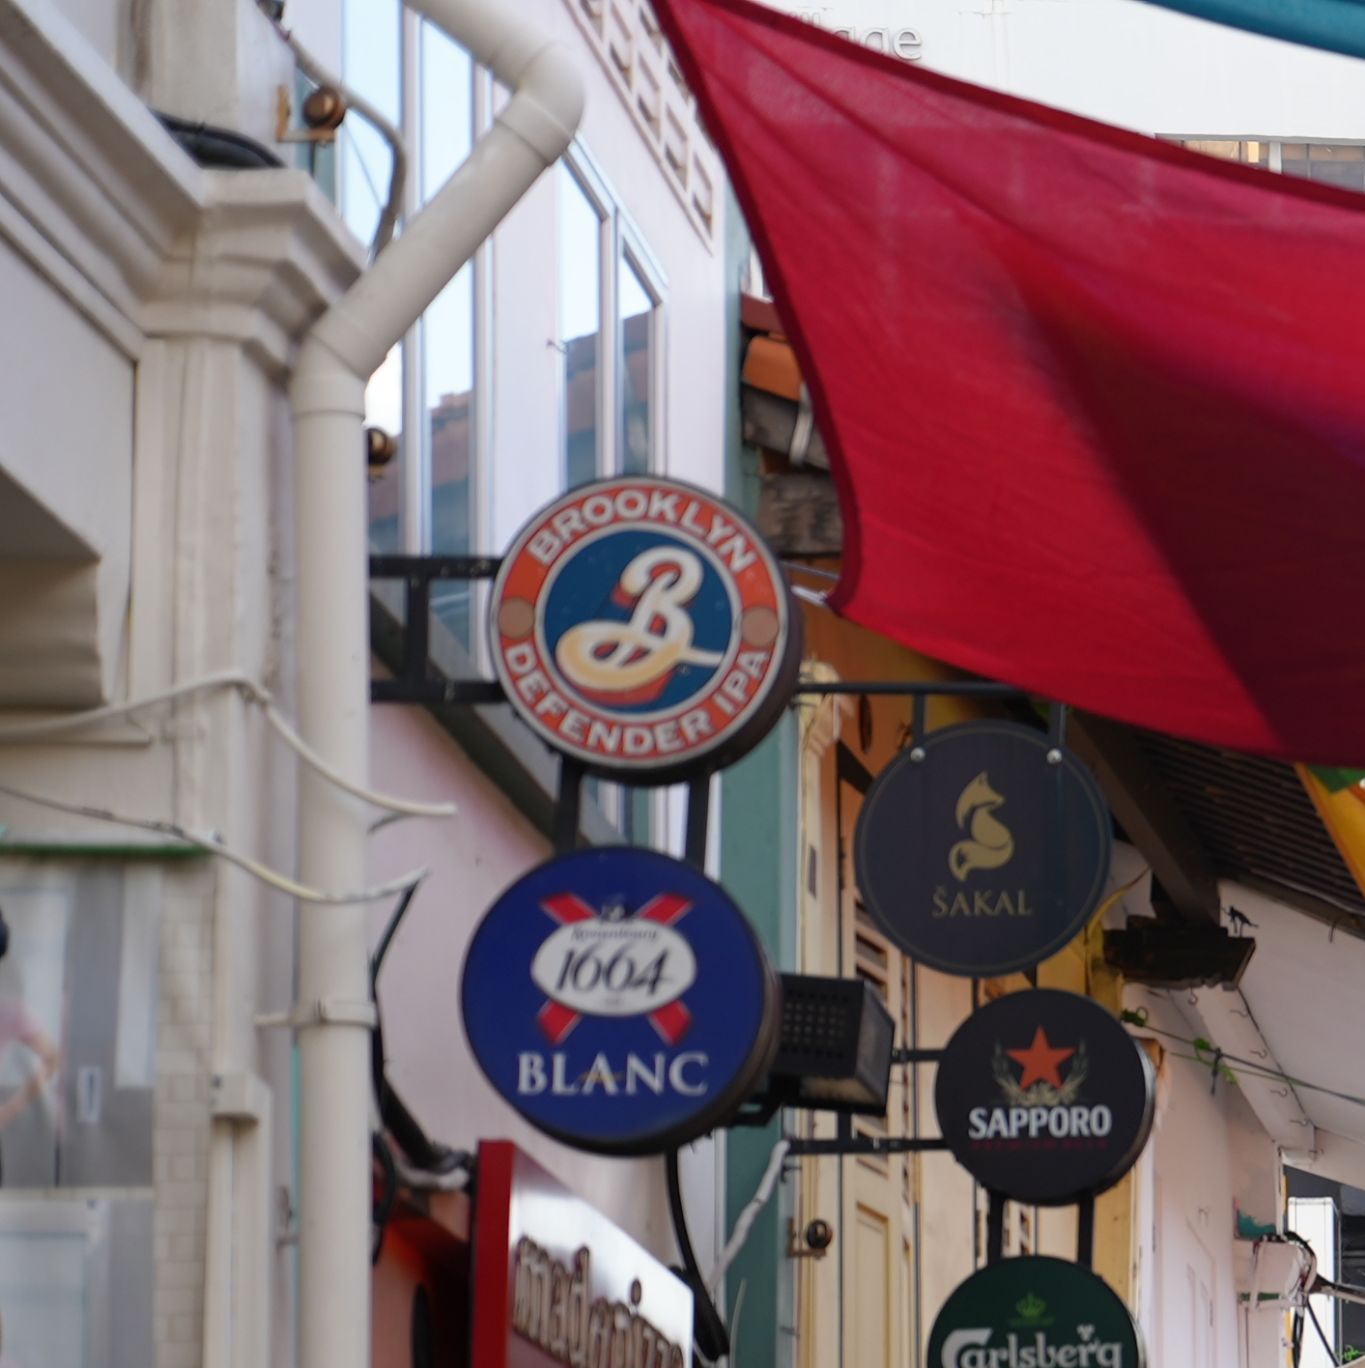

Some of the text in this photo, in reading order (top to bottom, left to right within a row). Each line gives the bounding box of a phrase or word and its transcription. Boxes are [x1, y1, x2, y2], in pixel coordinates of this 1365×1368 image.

[526, 489, 757, 573] BROOKLYN
[505, 643, 767, 754] DEFENDER IPA
[555, 943, 674, 998] 1664
[516, 1051, 710, 1097] BLANC
[968, 1104, 1113, 1140] SAPPORO
